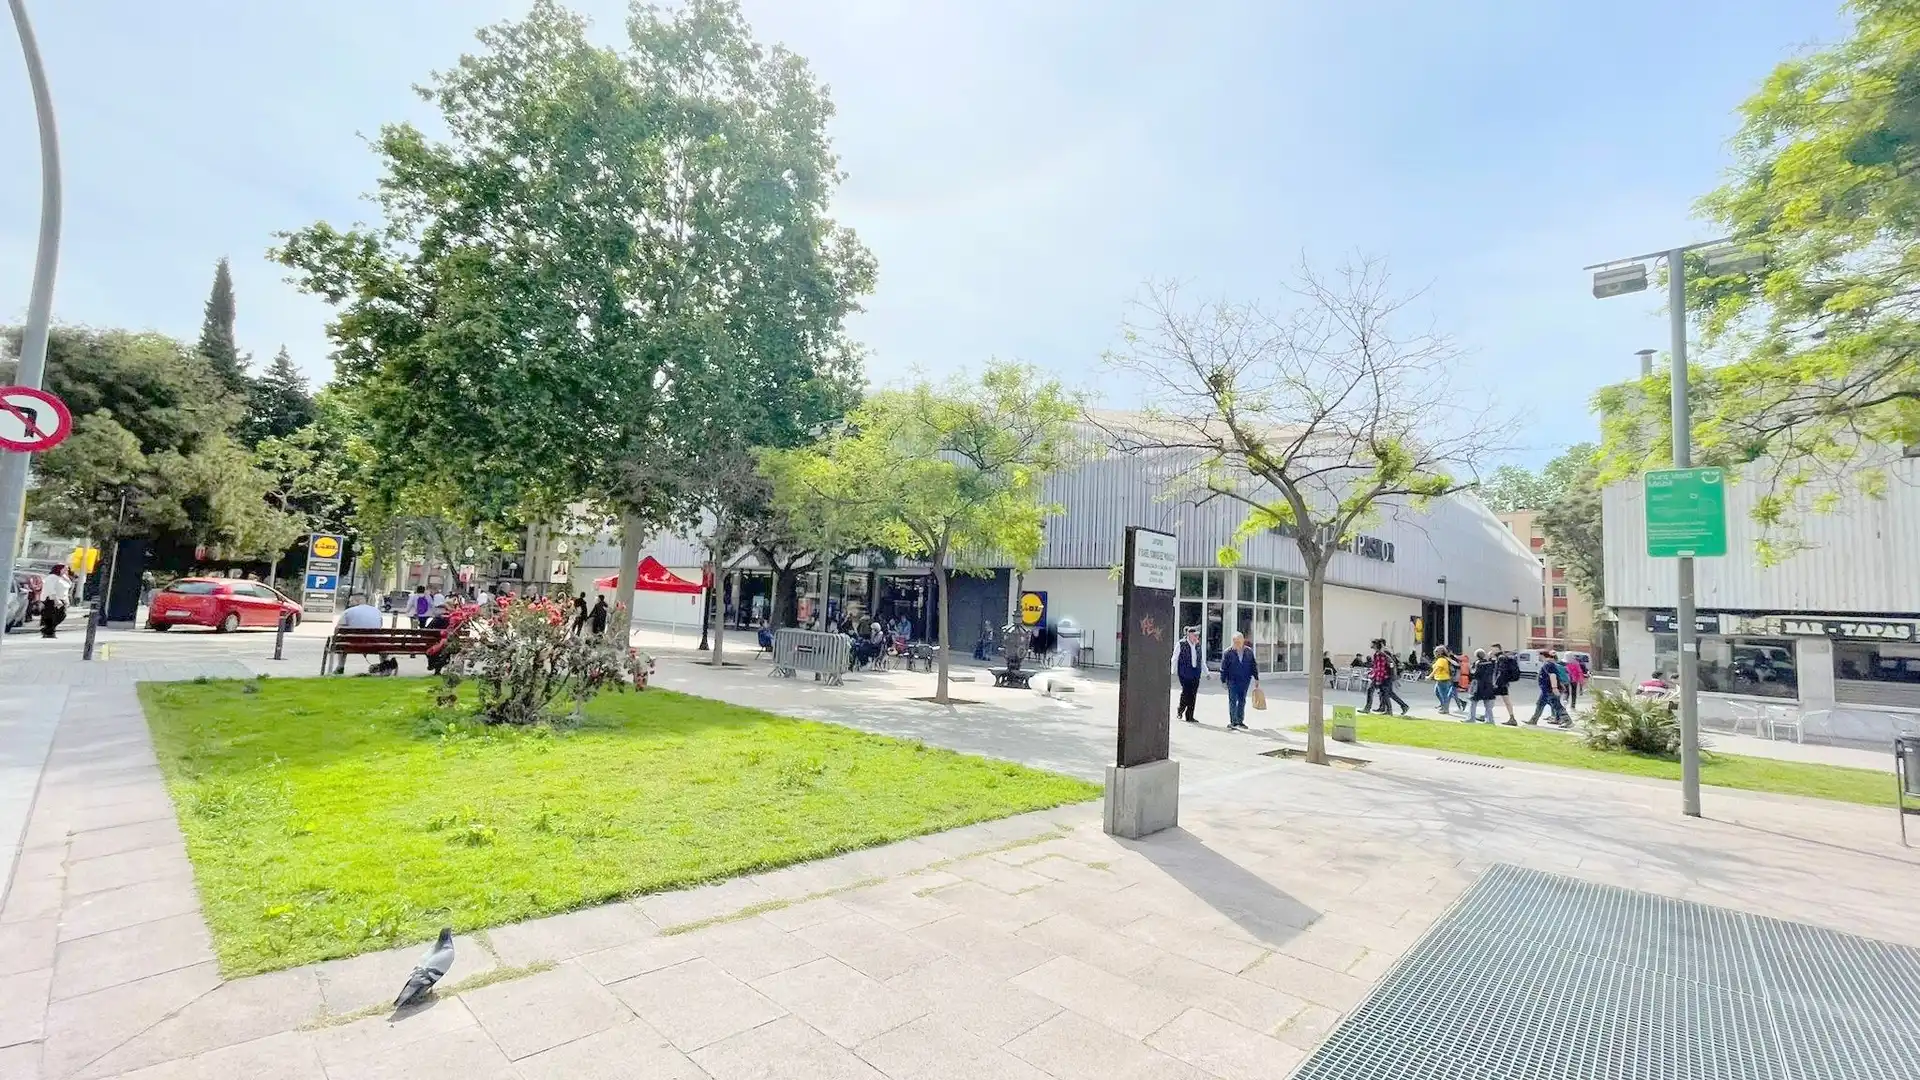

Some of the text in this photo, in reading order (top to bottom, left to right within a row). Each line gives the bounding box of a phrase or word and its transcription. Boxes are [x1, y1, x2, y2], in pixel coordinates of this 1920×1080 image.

[314, 575, 328, 589] P
[1784, 621, 1825, 635] BAR
[1840, 622, 1912, 640] TAPAS
